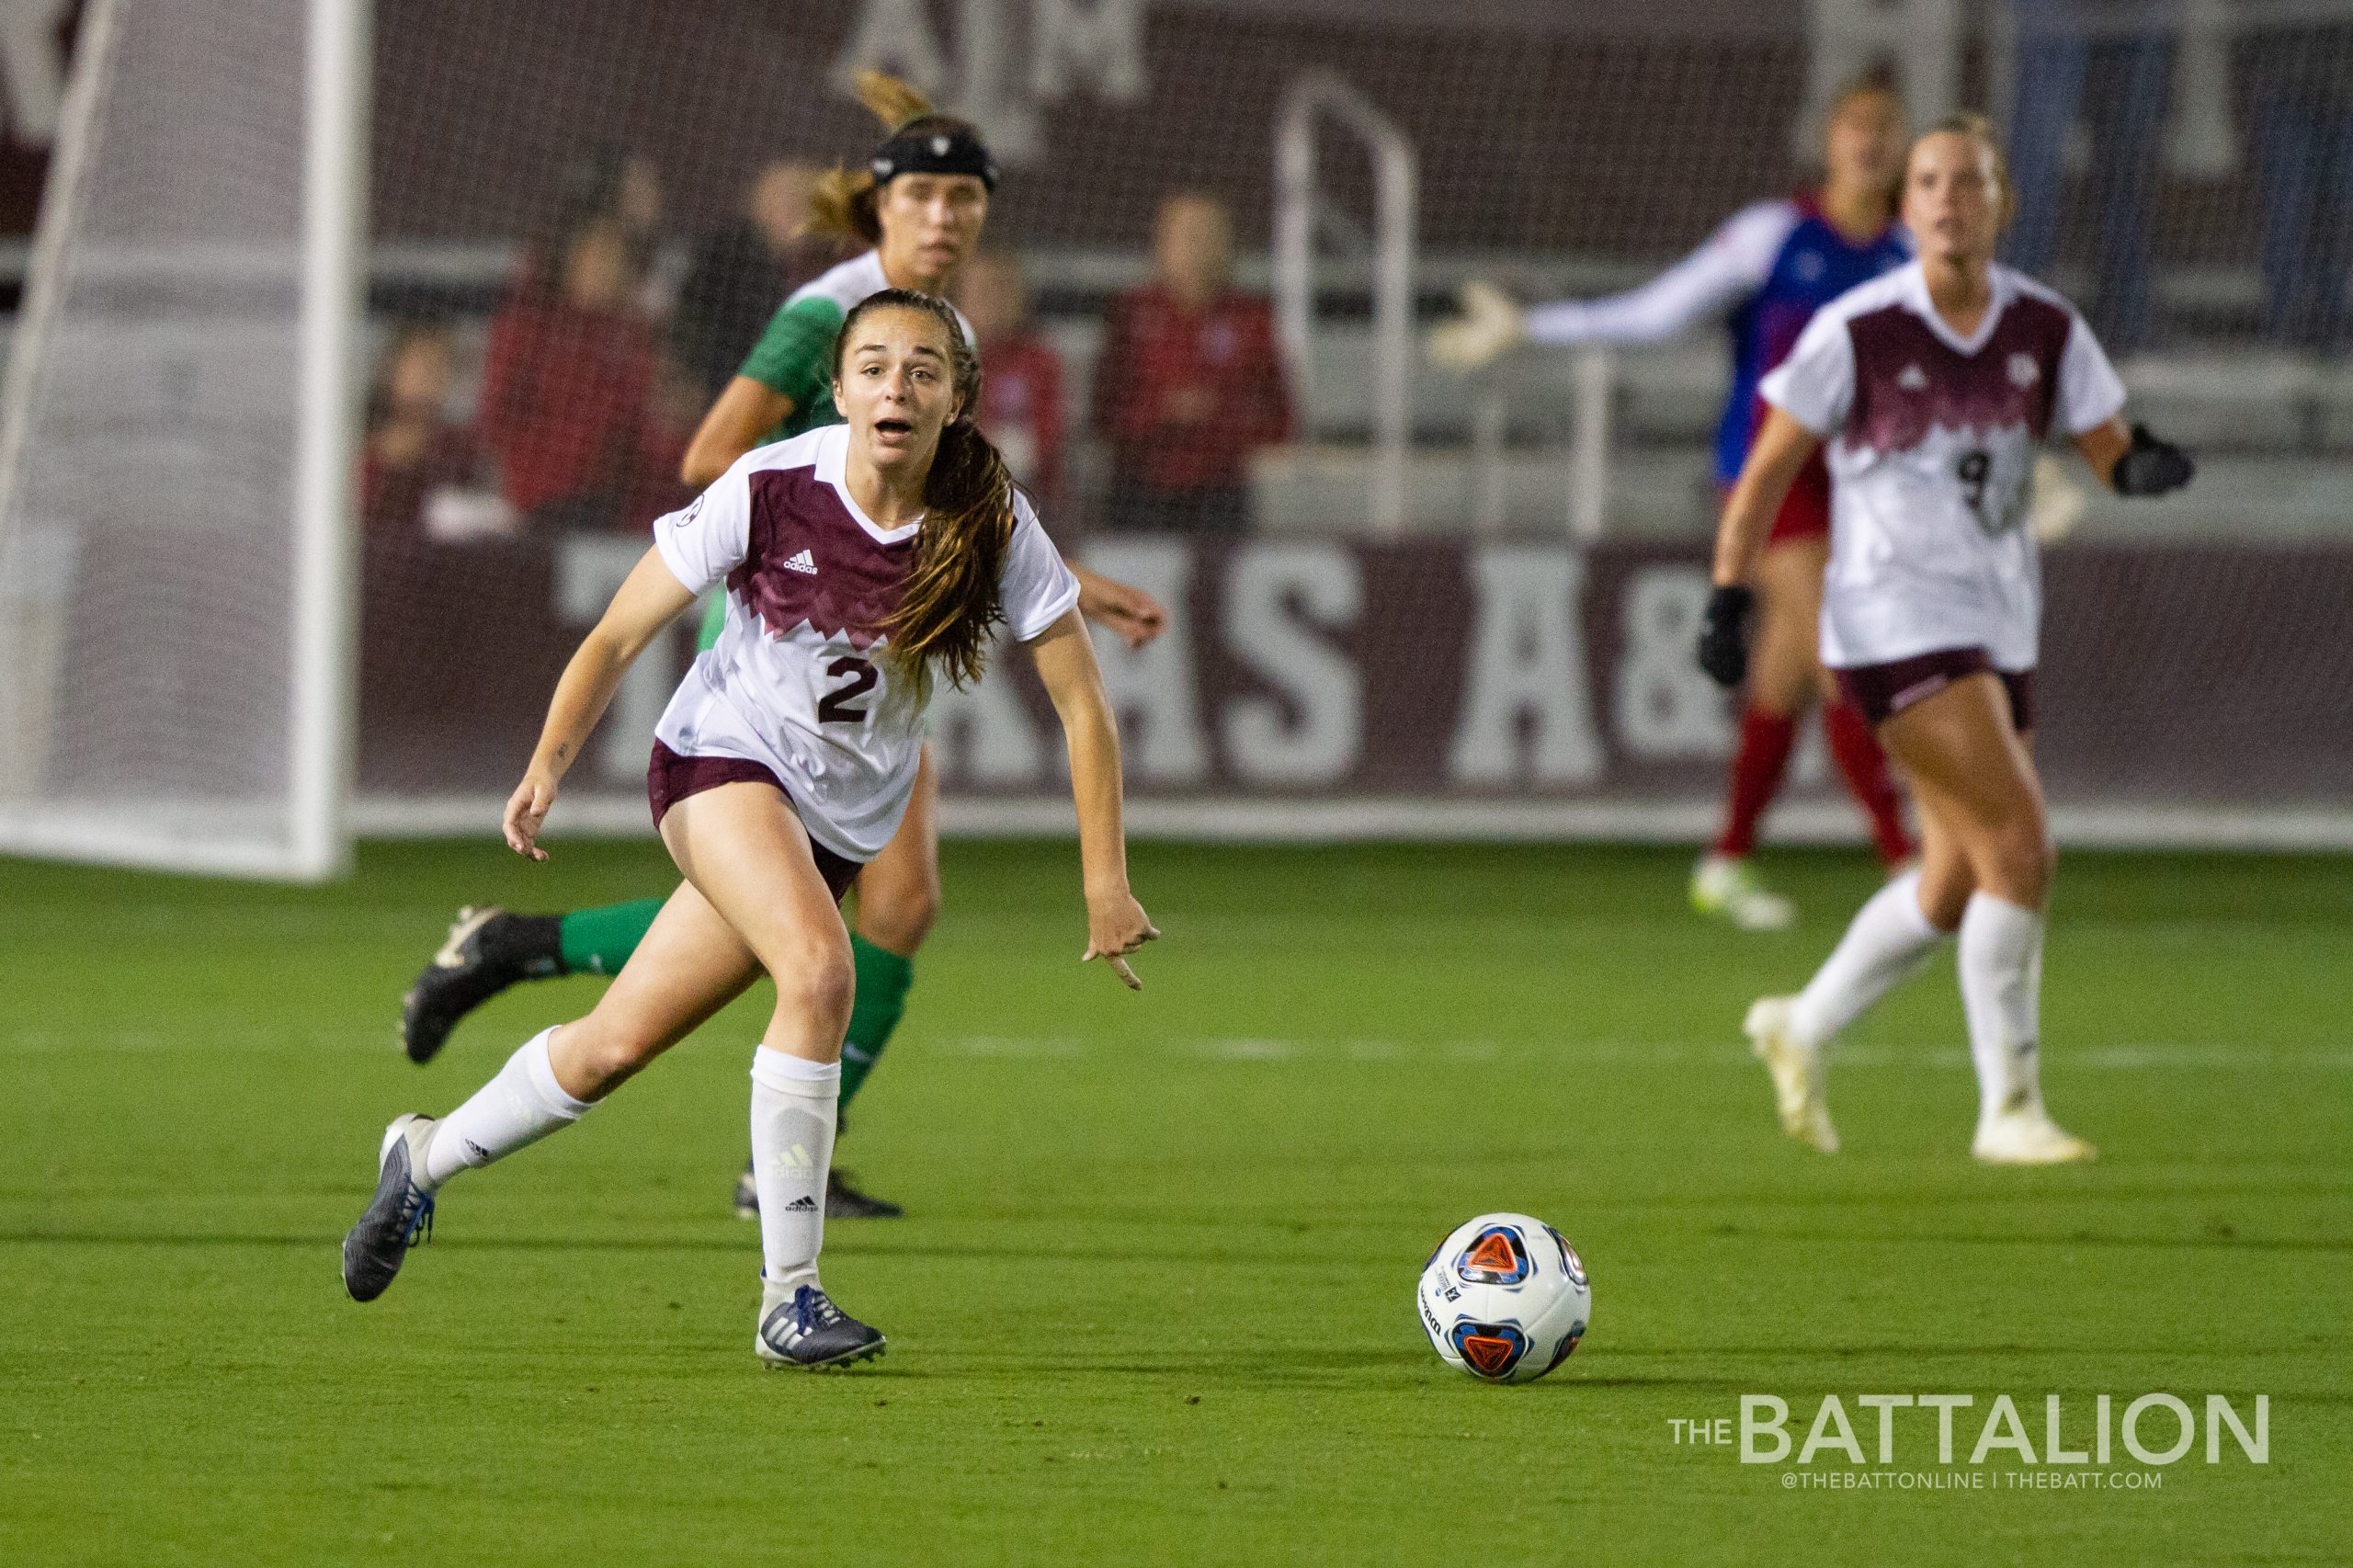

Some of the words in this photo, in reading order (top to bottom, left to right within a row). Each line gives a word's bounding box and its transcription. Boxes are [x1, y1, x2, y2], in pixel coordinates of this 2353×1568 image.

[1955, 449, 1991, 511] 9
[783, 560, 818, 575] adidas
[818, 656, 879, 723] 2
